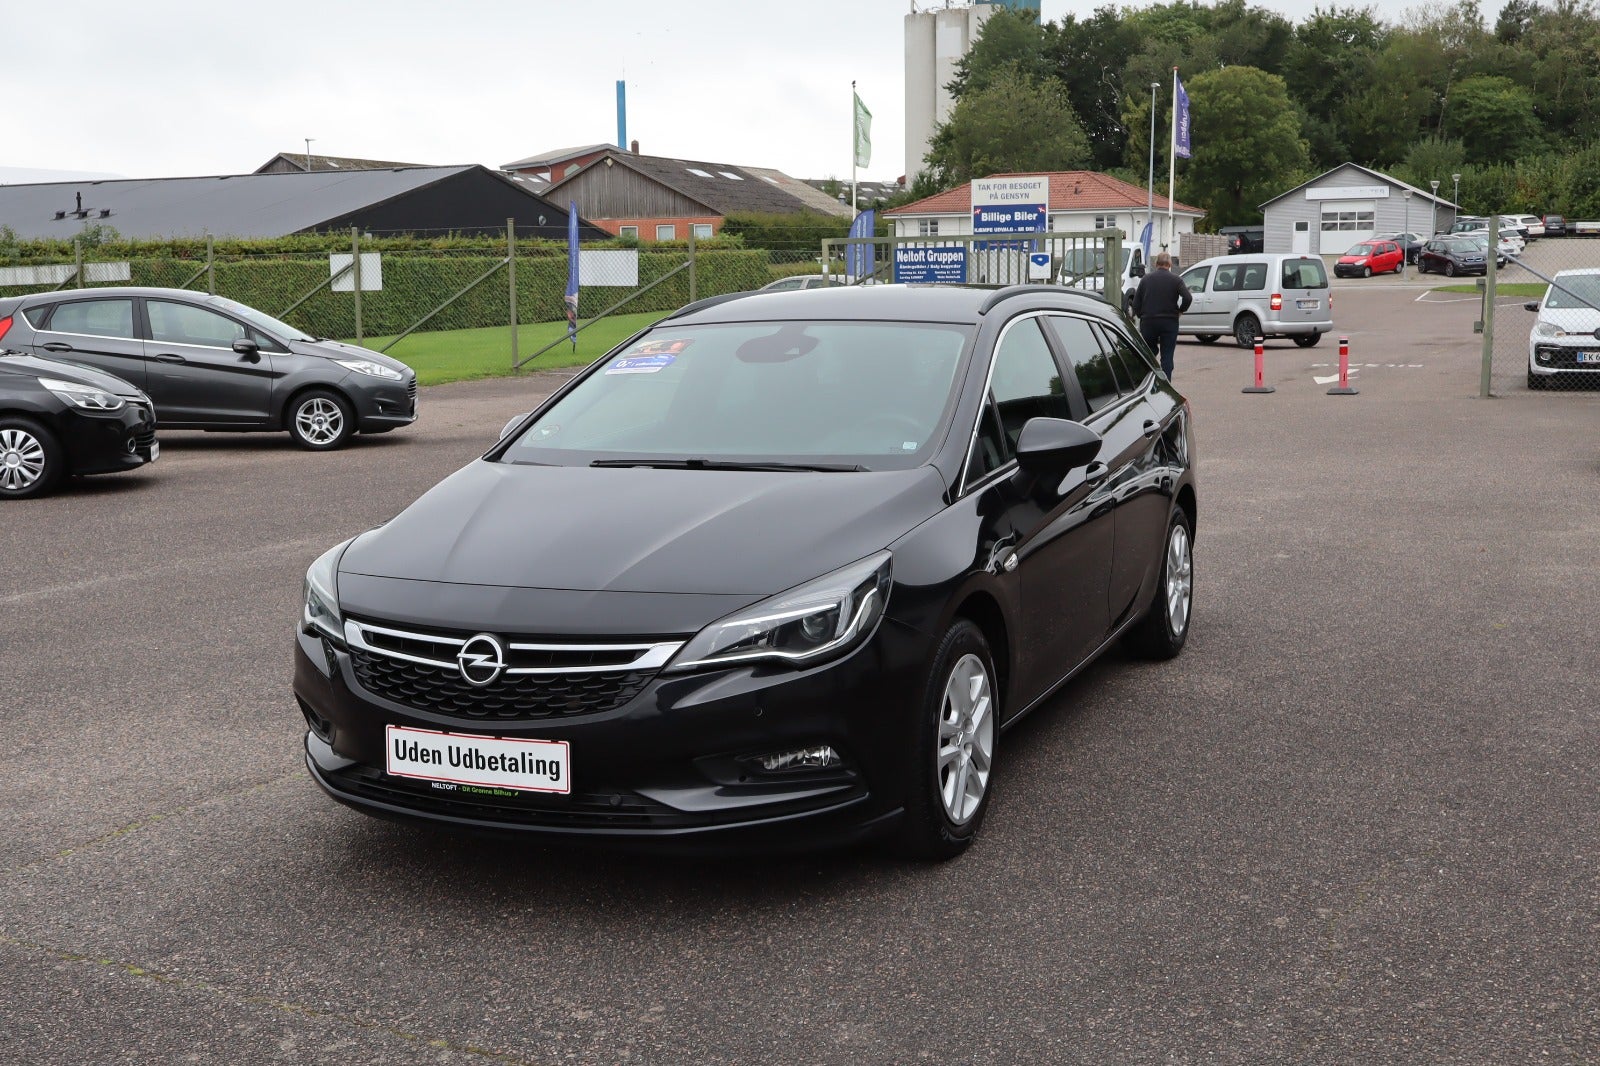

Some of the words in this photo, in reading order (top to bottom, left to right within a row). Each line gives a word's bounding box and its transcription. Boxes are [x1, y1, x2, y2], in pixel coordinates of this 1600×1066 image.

[1009, 182, 1042, 190] BESØGET
[989, 192, 998, 200] PÅ
[1000, 192, 1030, 200] GENSYN
[981, 211, 1012, 223] Billige
[1014, 211, 1038, 221] Biler
[896, 250, 926, 263] Neltoft
[927, 249, 964, 264] Gruppen
[394, 738, 442, 765] Uden
[448, 745, 561, 782] Udbetaling
[431, 781, 458, 791] NELTOFT
